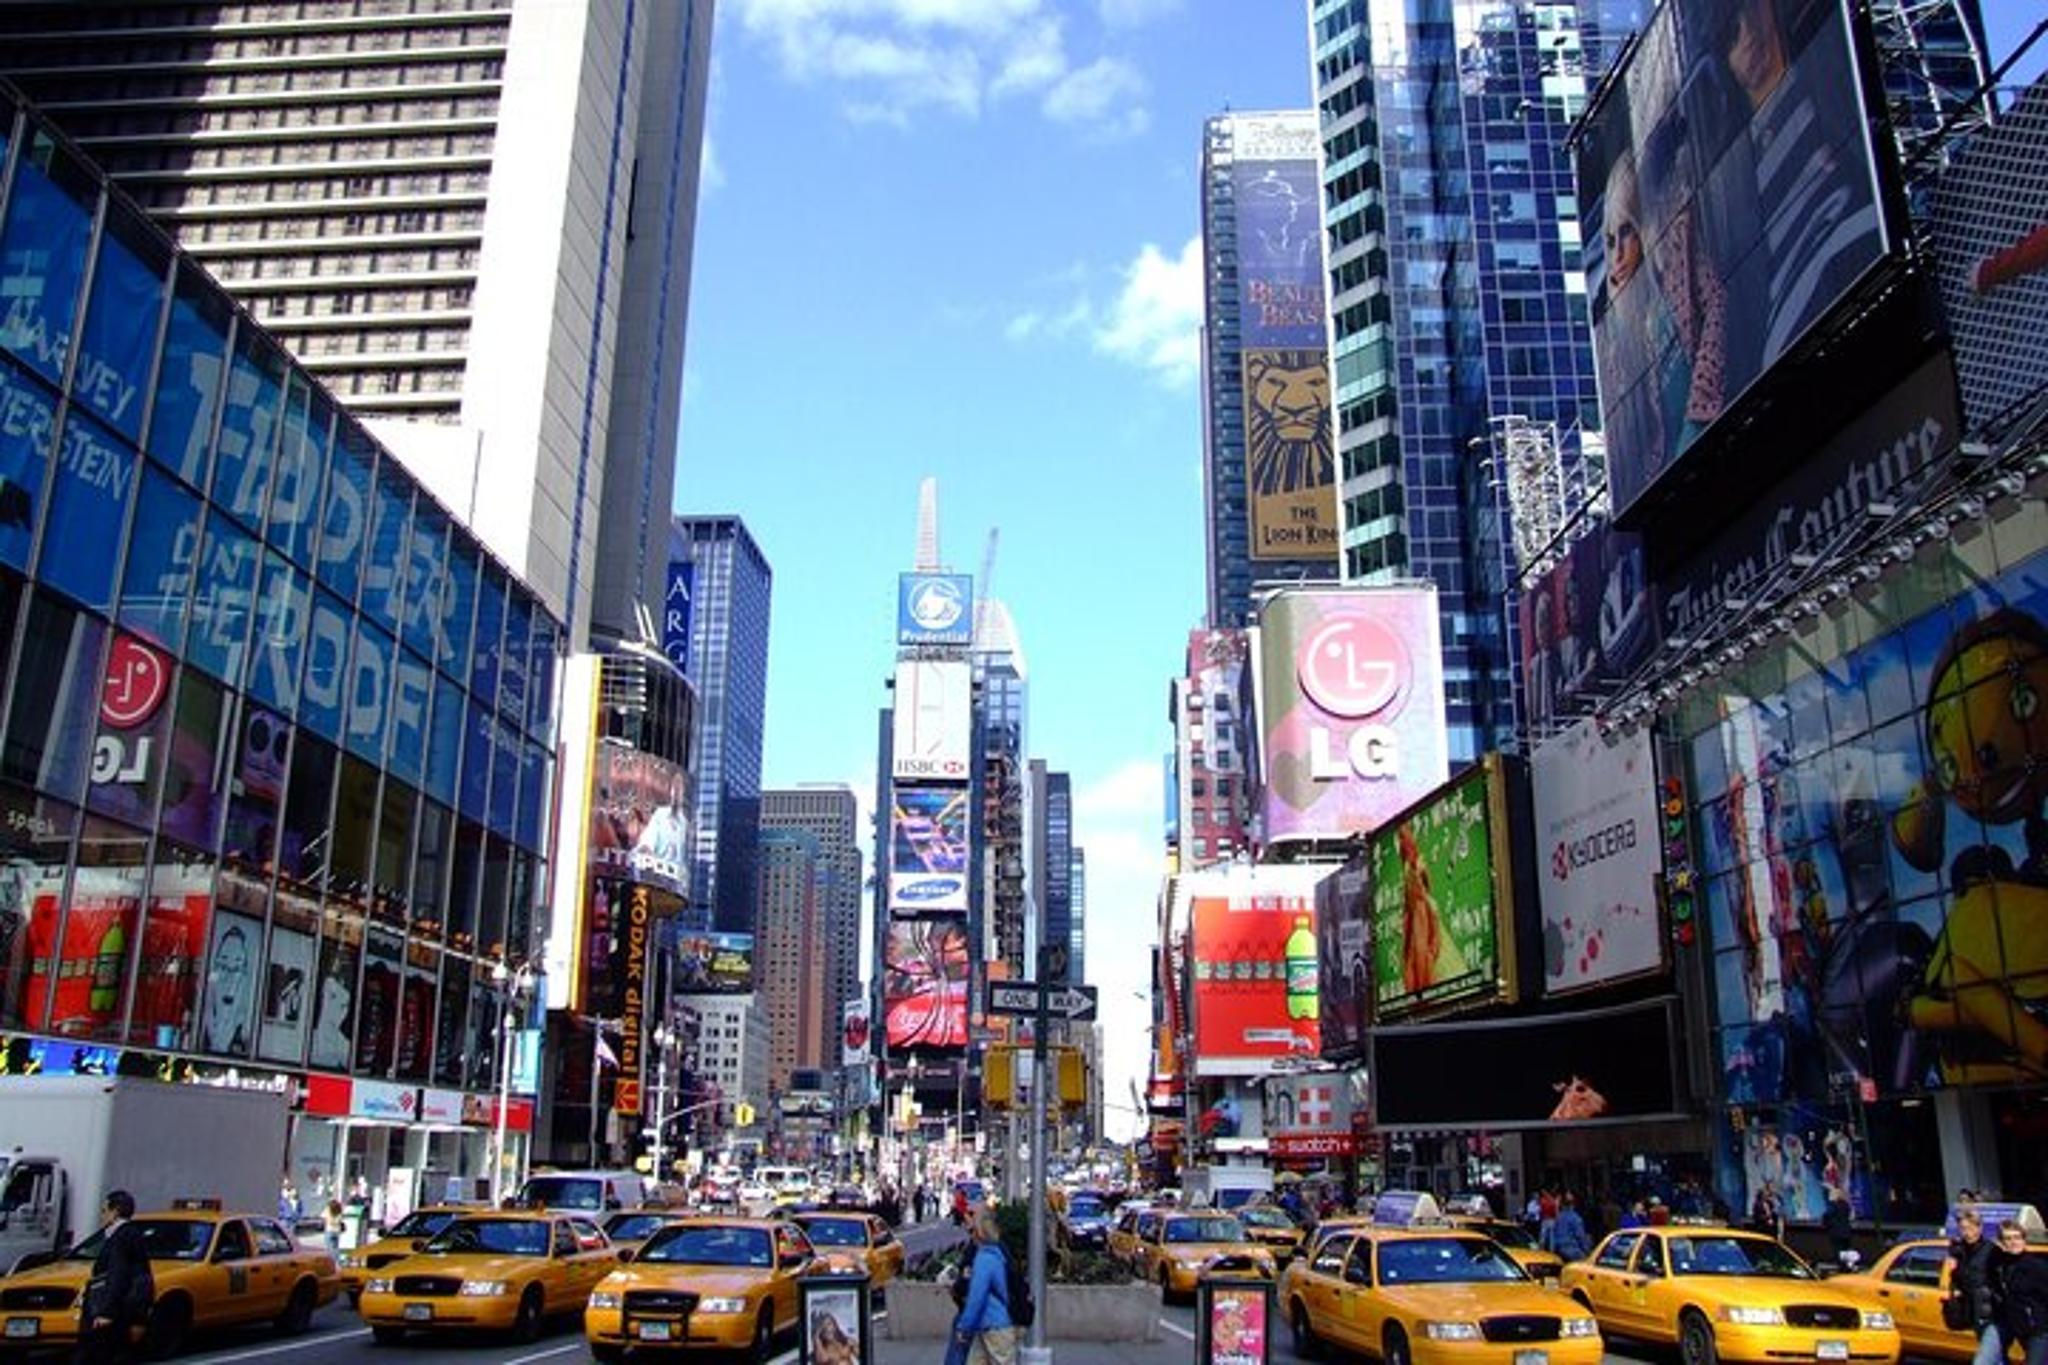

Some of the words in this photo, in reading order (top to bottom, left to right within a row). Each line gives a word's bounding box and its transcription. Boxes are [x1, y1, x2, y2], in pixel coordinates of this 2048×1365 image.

[1290, 506, 1317, 520] THE
[1263, 525, 1302, 545] LION
[1305, 525, 1338, 545] KIN
[900, 630, 968, 644] Prudential
[1311, 726, 1399, 783] LG
[896, 759, 938, 774] HSBC
[627, 888, 648, 979] KODAK
[1003, 992, 1034, 1008] ONE
[622, 986, 641, 1072] digital
